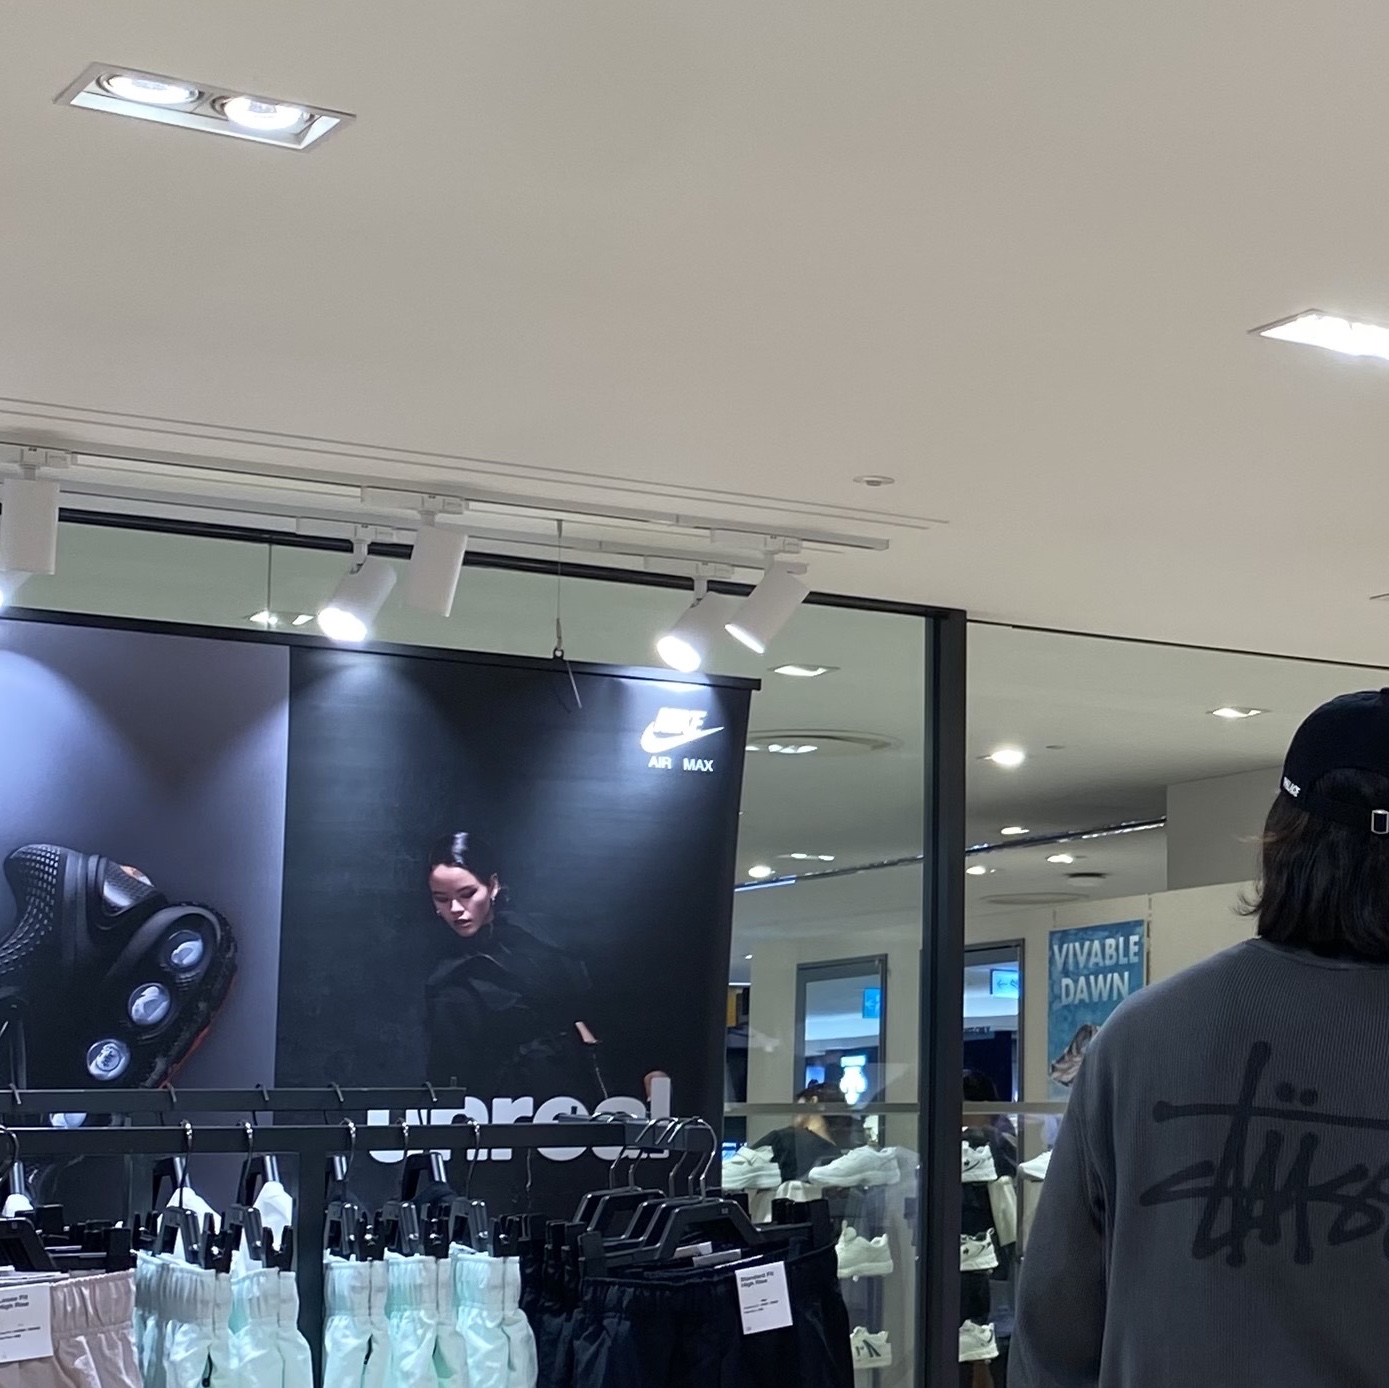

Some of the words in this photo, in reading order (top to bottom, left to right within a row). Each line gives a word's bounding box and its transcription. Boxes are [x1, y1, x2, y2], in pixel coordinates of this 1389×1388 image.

[647, 755, 673, 770] AIR
[683, 757, 715, 772] MAX
[1053, 934, 1140, 971] VIVABLE
[1060, 971, 1130, 1006] DAWN
